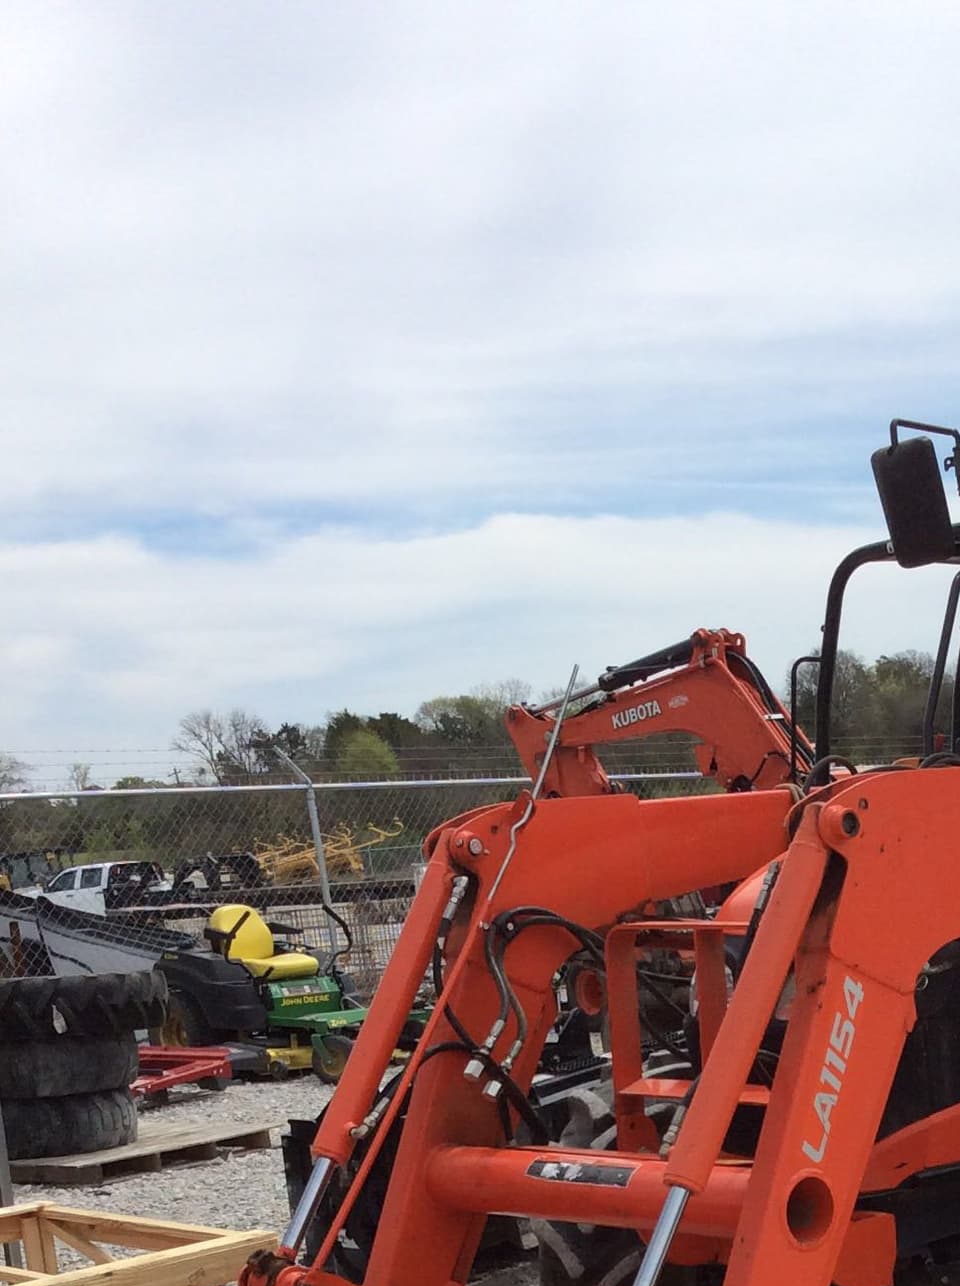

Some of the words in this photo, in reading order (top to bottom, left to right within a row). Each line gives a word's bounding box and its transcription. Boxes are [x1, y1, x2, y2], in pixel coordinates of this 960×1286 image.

[611, 700, 662, 729] KUBOTA
[281, 996, 302, 1007] JOHN
[303, 994, 330, 1004] DEERE
[802, 975, 865, 1163] LA1154
